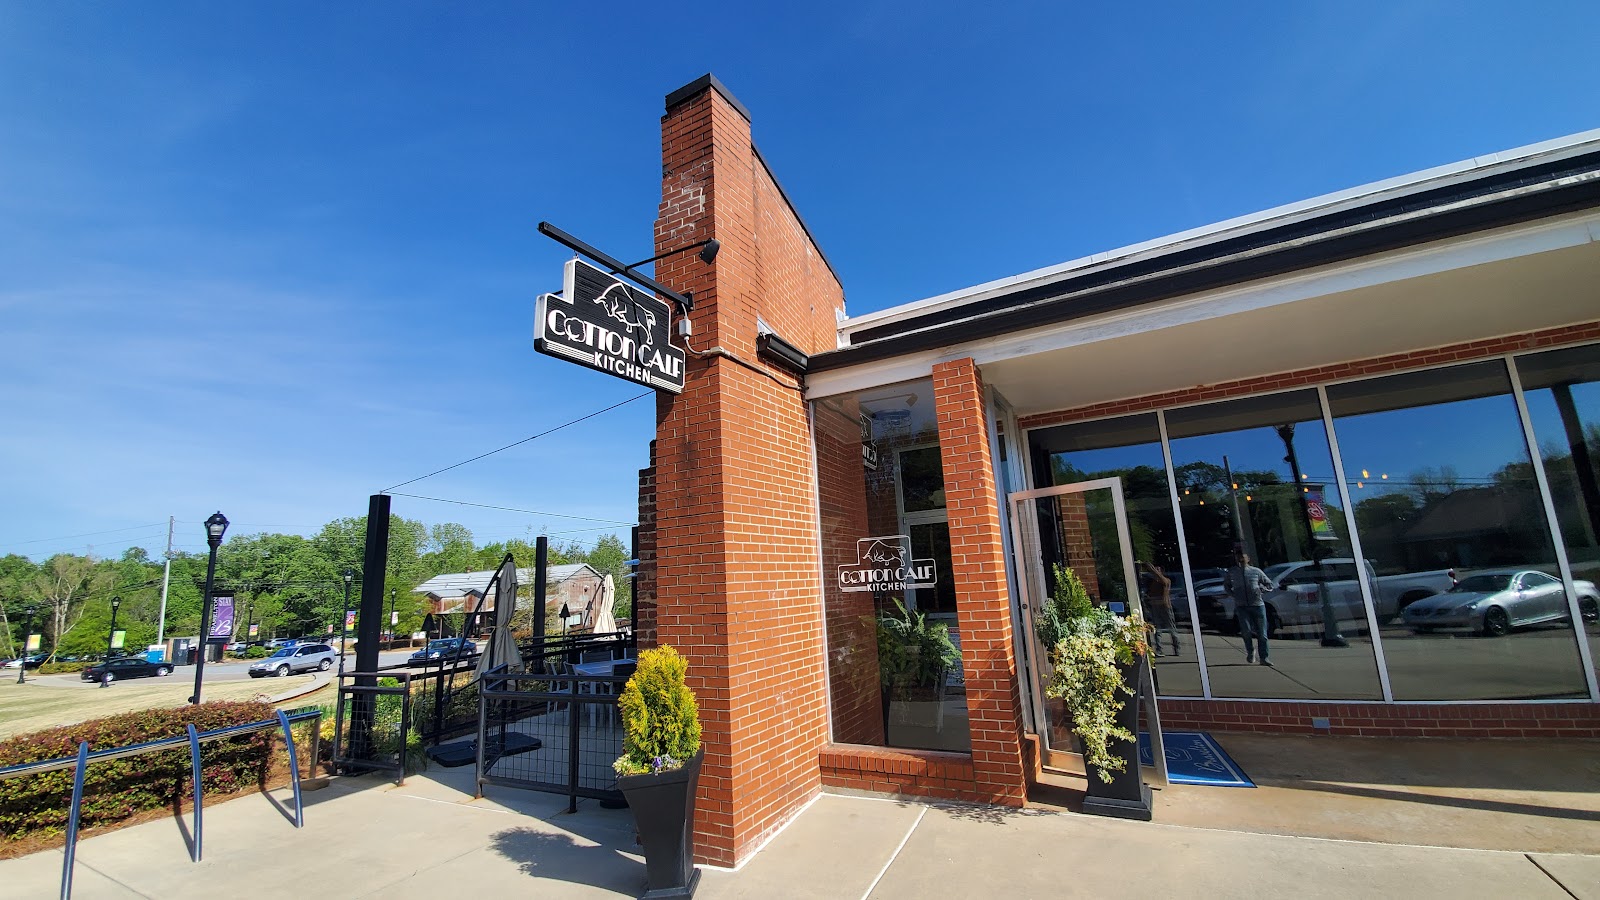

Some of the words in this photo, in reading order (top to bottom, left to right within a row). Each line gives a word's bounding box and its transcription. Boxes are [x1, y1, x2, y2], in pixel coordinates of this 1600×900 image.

[548, 310, 636, 361] COTTON
[638, 344, 683, 378] CALF
[594, 352, 651, 383] KITCHEN
[841, 569, 893, 584] COTTON
[895, 566, 933, 580] CALF
[867, 582, 907, 592] KITCHEN
